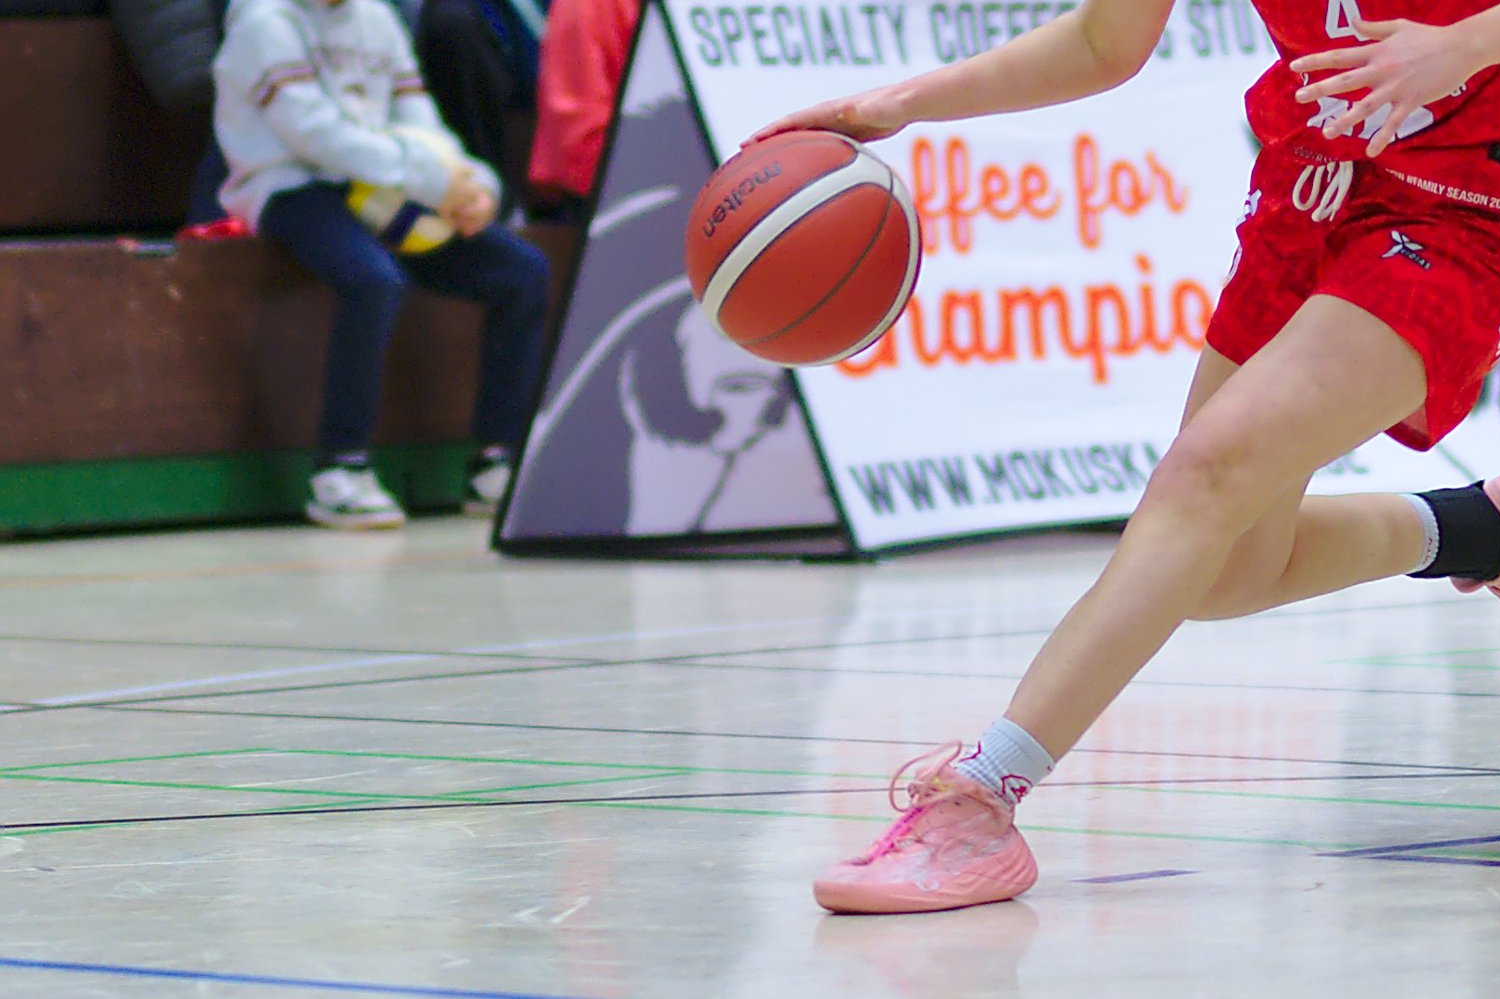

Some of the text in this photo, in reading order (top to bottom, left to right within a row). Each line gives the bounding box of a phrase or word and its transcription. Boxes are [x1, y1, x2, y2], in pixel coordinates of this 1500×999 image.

[689, 4, 910, 67] SPECIALTY
[930, 2, 1076, 64] COFF
[703, 161, 782, 238] molten
[911, 133, 1188, 256] ffee for
[1446, 187, 1489, 206] SEASON
[848, 441, 1160, 516] WWW.MOKUSK
